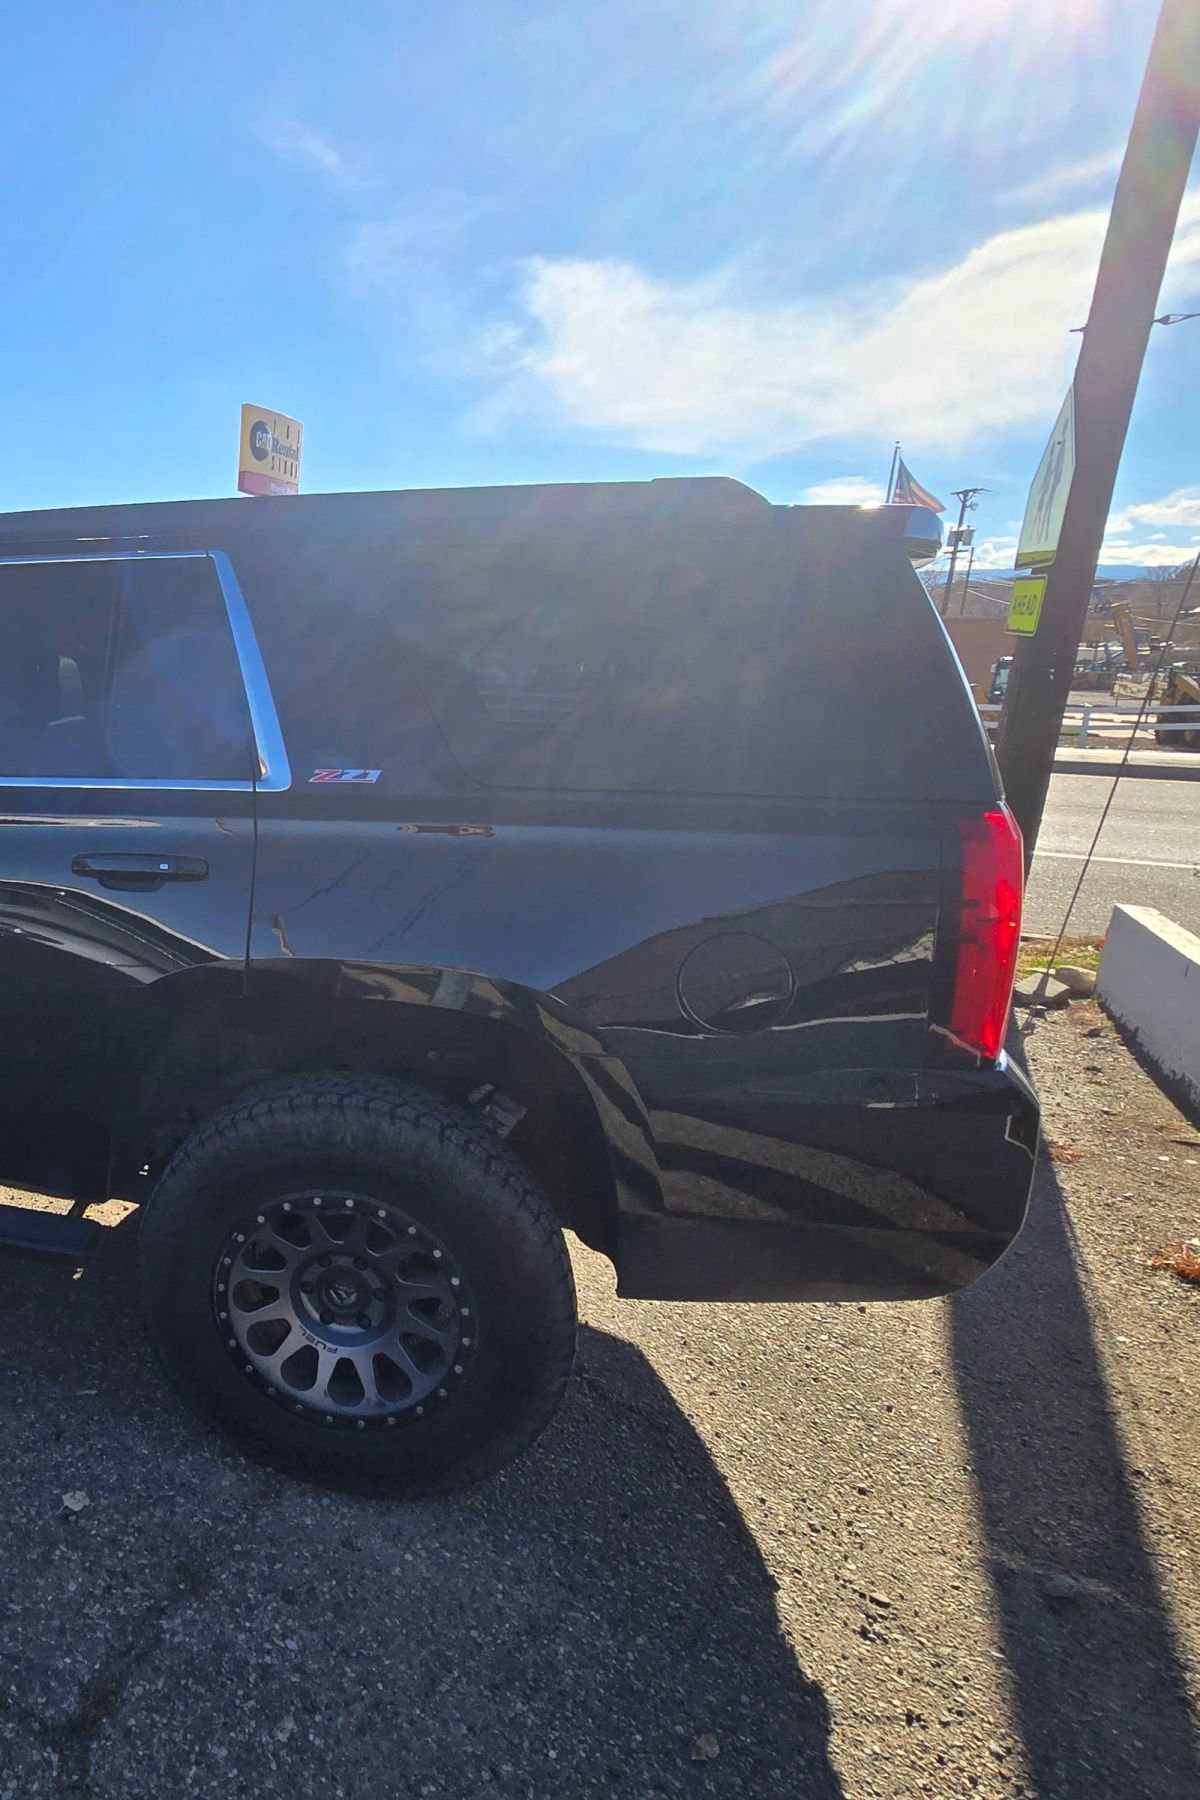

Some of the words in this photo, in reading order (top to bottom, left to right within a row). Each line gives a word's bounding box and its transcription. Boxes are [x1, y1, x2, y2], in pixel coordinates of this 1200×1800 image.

[1012, 594, 1038, 616] AHEAD
[308, 767, 382, 784] Z71
[299, 1324, 339, 1354] FUEL
